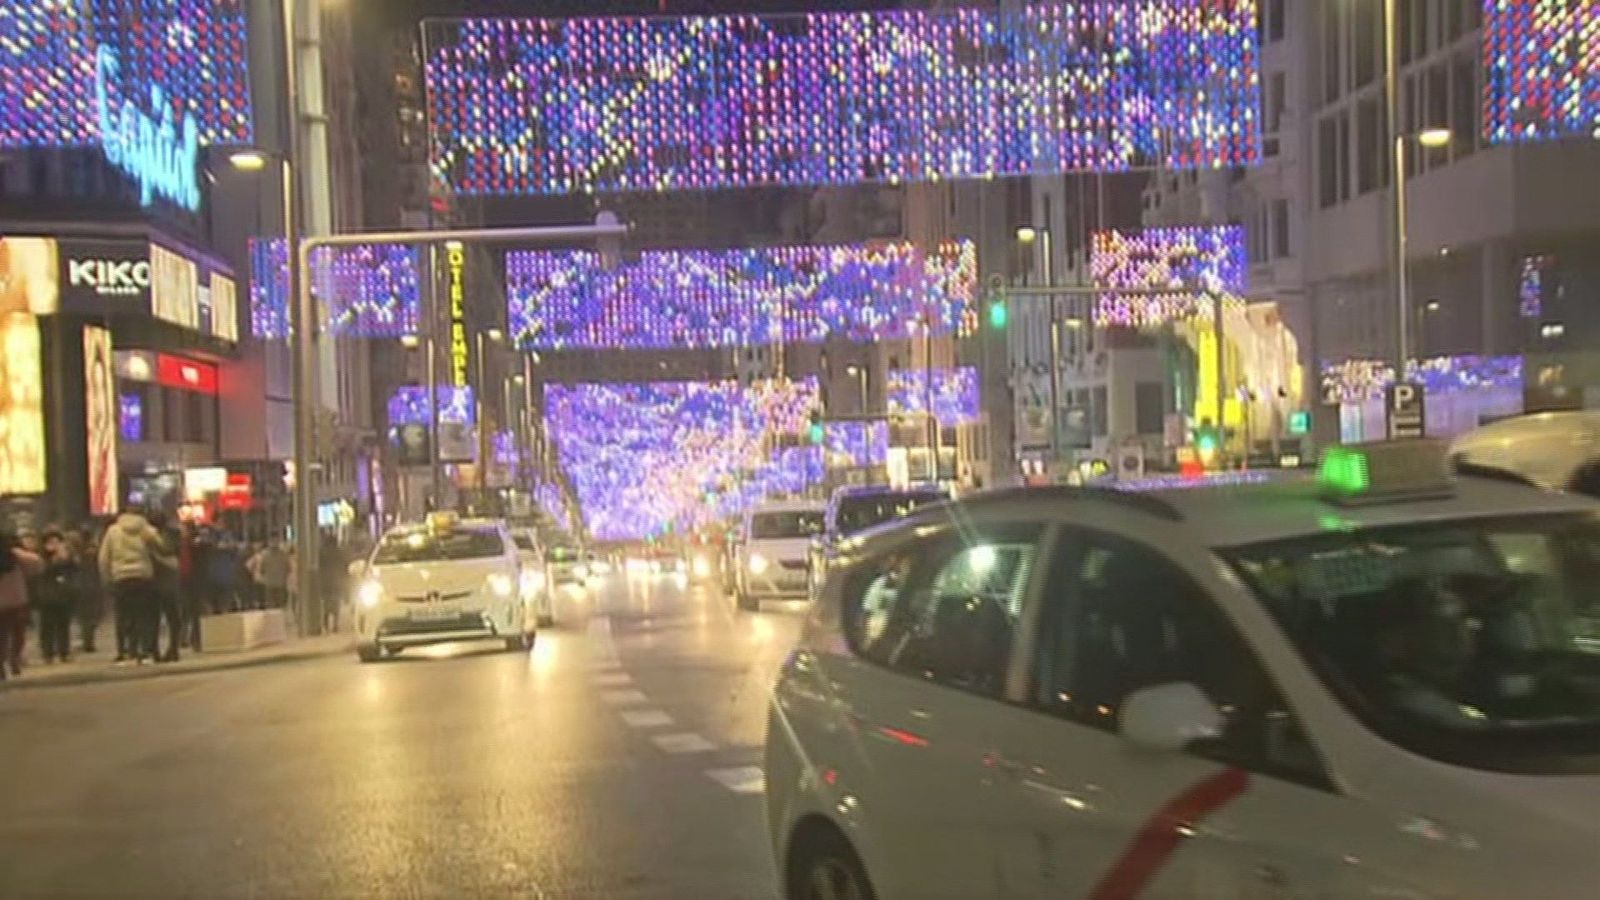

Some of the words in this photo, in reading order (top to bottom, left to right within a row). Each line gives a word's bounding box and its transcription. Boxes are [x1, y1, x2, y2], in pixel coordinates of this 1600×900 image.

[69, 258, 150, 286] KIKO
[447, 241, 464, 318] OTEL
[1394, 385, 1414, 410] P
